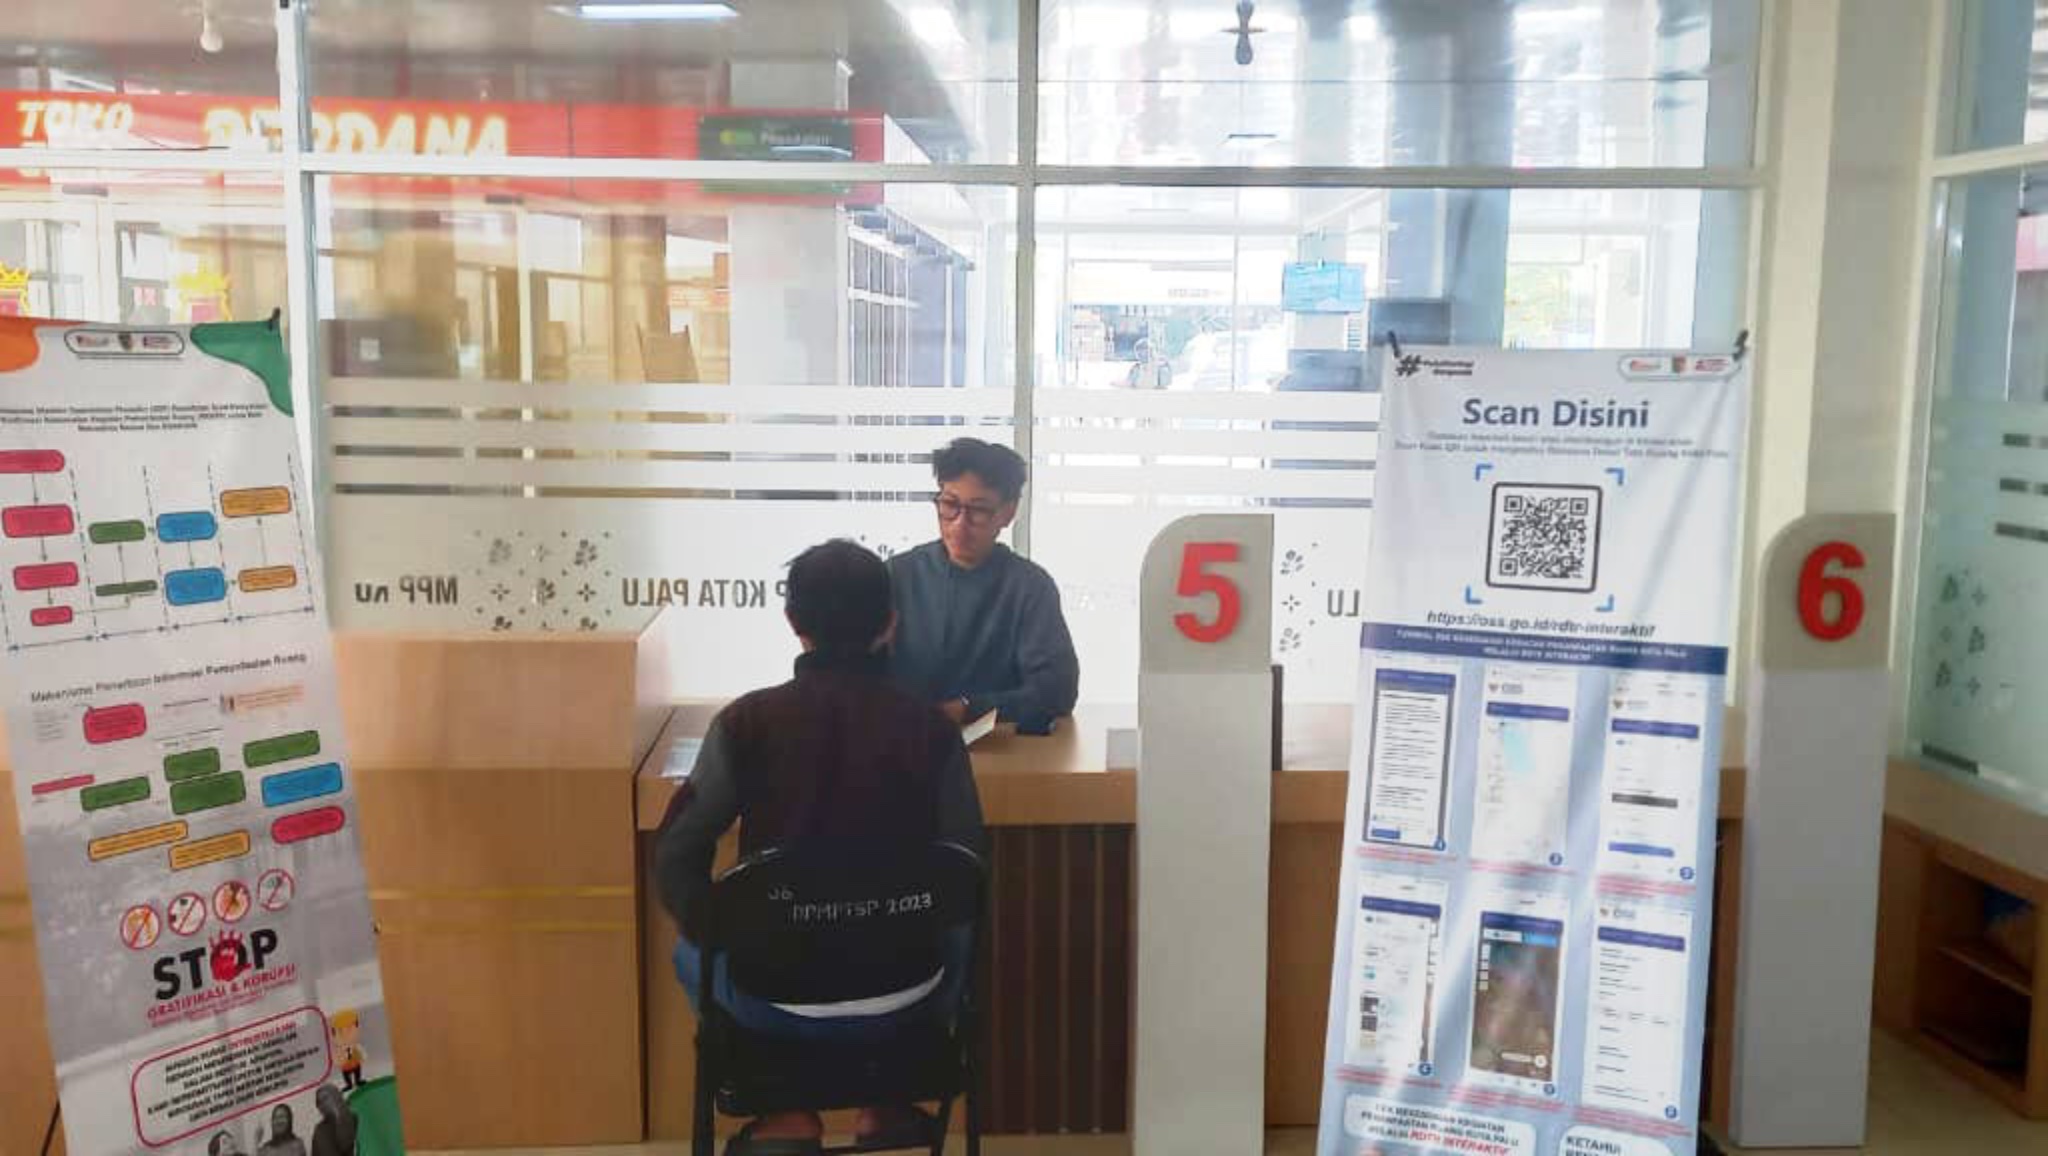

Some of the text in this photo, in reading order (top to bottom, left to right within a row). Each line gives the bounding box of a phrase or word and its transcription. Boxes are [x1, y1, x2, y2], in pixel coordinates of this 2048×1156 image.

[16, 100, 133, 140] TOKO
[1462, 399, 1649, 427] Scan Disini
[1174, 542, 1241, 643] 5
[1797, 540, 1866, 642] 6
[887, 892, 932, 915] 2023
[153, 929, 278, 1000] STOP
